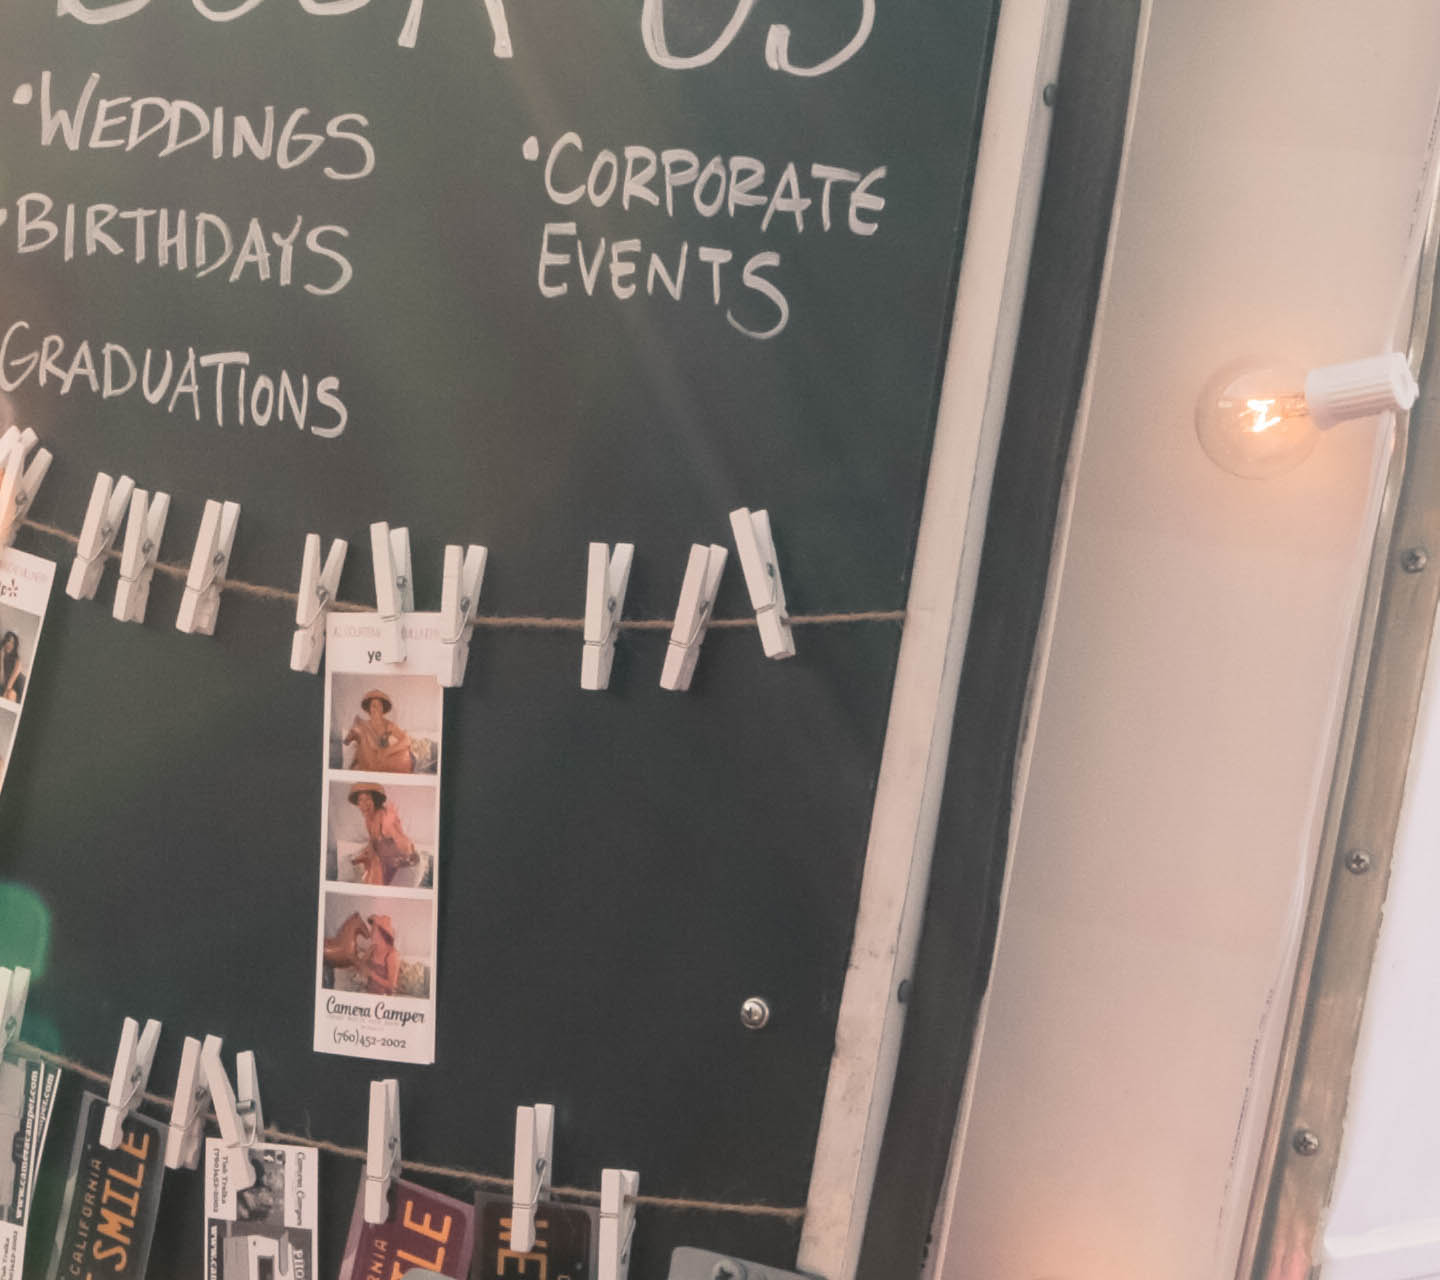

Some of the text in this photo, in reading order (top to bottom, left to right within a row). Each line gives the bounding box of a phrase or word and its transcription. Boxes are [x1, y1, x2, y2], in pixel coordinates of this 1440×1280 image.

[40, 70, 376, 181] WEDDINGS
[544, 131, 888, 237] CORPORATE
[16, 192, 354, 296] BIRTHDAYS
[537, 222, 791, 340] EVENTS
[326, 995, 371, 1018] Camera
[374, 1001, 425, 1027] Camper
[71, 1159, 102, 1276] CALIFORNIA
[93, 1132, 150, 1272] SMILE
